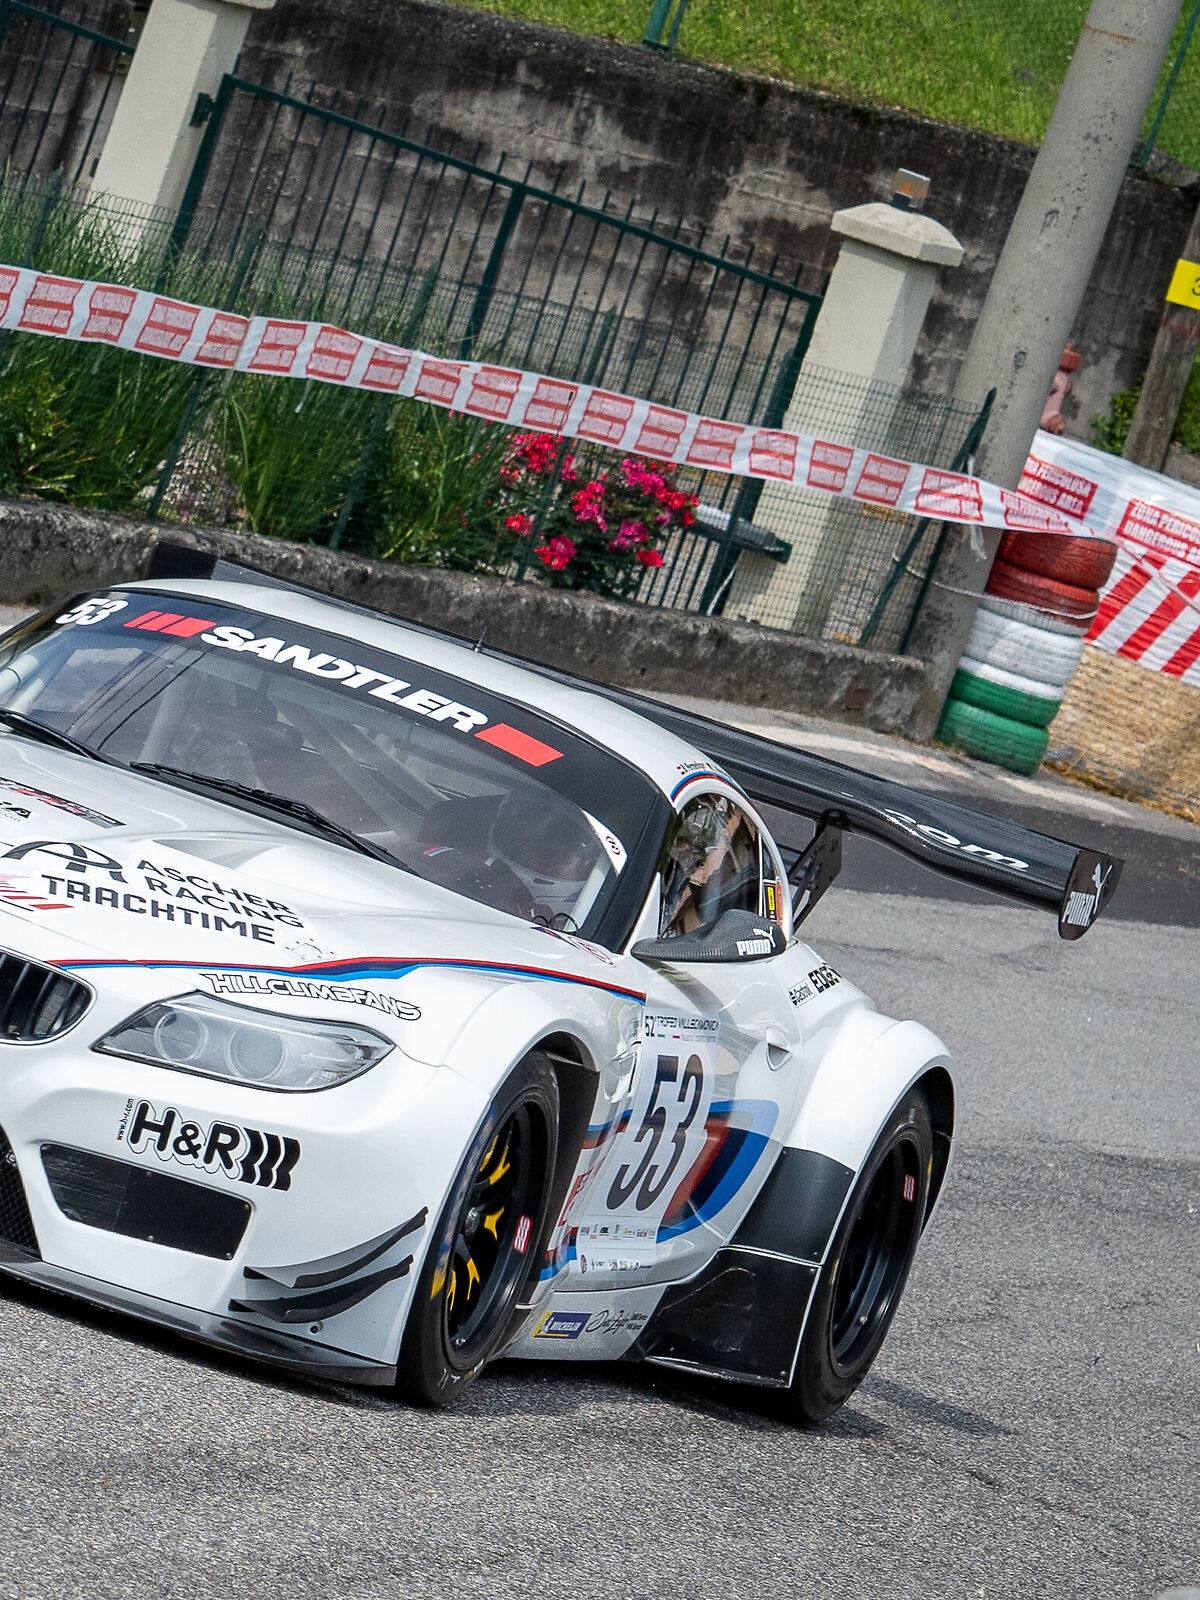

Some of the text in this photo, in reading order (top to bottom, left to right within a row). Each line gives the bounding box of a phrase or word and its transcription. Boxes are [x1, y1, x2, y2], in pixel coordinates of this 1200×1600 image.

[55, 597, 129, 627] 53
[200, 625, 490, 734] SANDTLER
[136, 859, 297, 915] ASCHER
[144, 876, 305, 929] RACING
[736, 938, 772, 957] PUMA
[129, 1102, 242, 1171] H&R
[606, 1053, 704, 1212] 53
